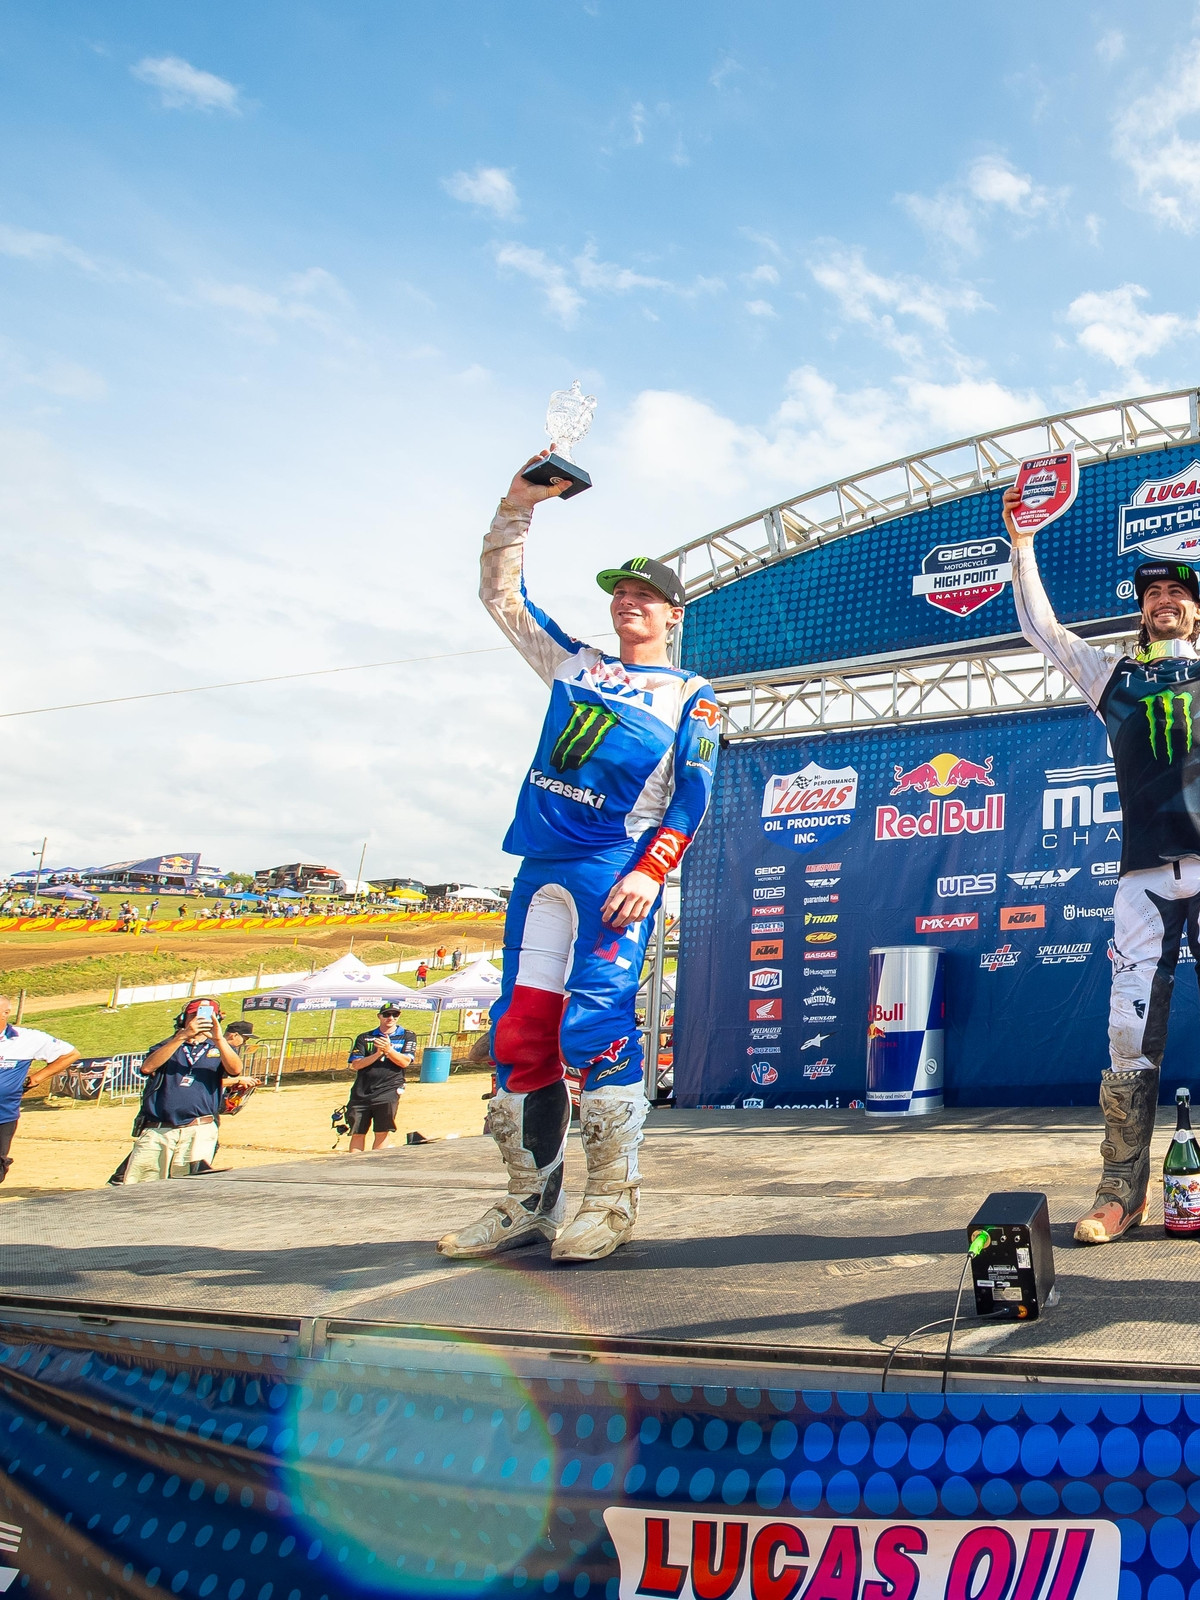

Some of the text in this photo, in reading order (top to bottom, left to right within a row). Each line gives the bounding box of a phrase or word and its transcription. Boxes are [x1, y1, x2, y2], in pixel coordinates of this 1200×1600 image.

[938, 543, 996, 561] GEICO
[944, 559, 988, 571] MOTORCYCLE
[934, 568, 998, 589] HIGH POINT
[936, 587, 994, 599] NATIONAL
[813, 777, 856, 787] PERFORMANCE
[771, 785, 853, 814] LUCAS
[764, 814, 851, 831] OIL PRODUCTS
[875, 793, 1005, 841] Red Bull
[794, 832, 818, 844] INC.
[755, 866, 786, 876] GEICO
[1091, 861, 1120, 875] GEI
[1007, 868, 1081, 885] FLY
[937, 873, 997, 898] WPS
[753, 886, 786, 900] WPS
[803, 895, 829, 905] guaranteed
[1077, 905, 1114, 918] Husqva
[812, 915, 838, 924] THOR
[1008, 912, 1036, 924] KTM
[752, 922, 784, 930] PARTS
[805, 933, 837, 942] FMF
[755, 945, 779, 955] KTM
[1037, 943, 1092, 955] SPECIALIZED
[981, 952, 1020, 963] VERTEX
[754, 973, 778, 986] 100%
[873, 1003, 903, 1022] Bull
[751, 1027, 782, 1035] SPECIALIZED
[804, 1064, 836, 1074] VERTEX
[637, 1517, 928, 1600] LUCAS
